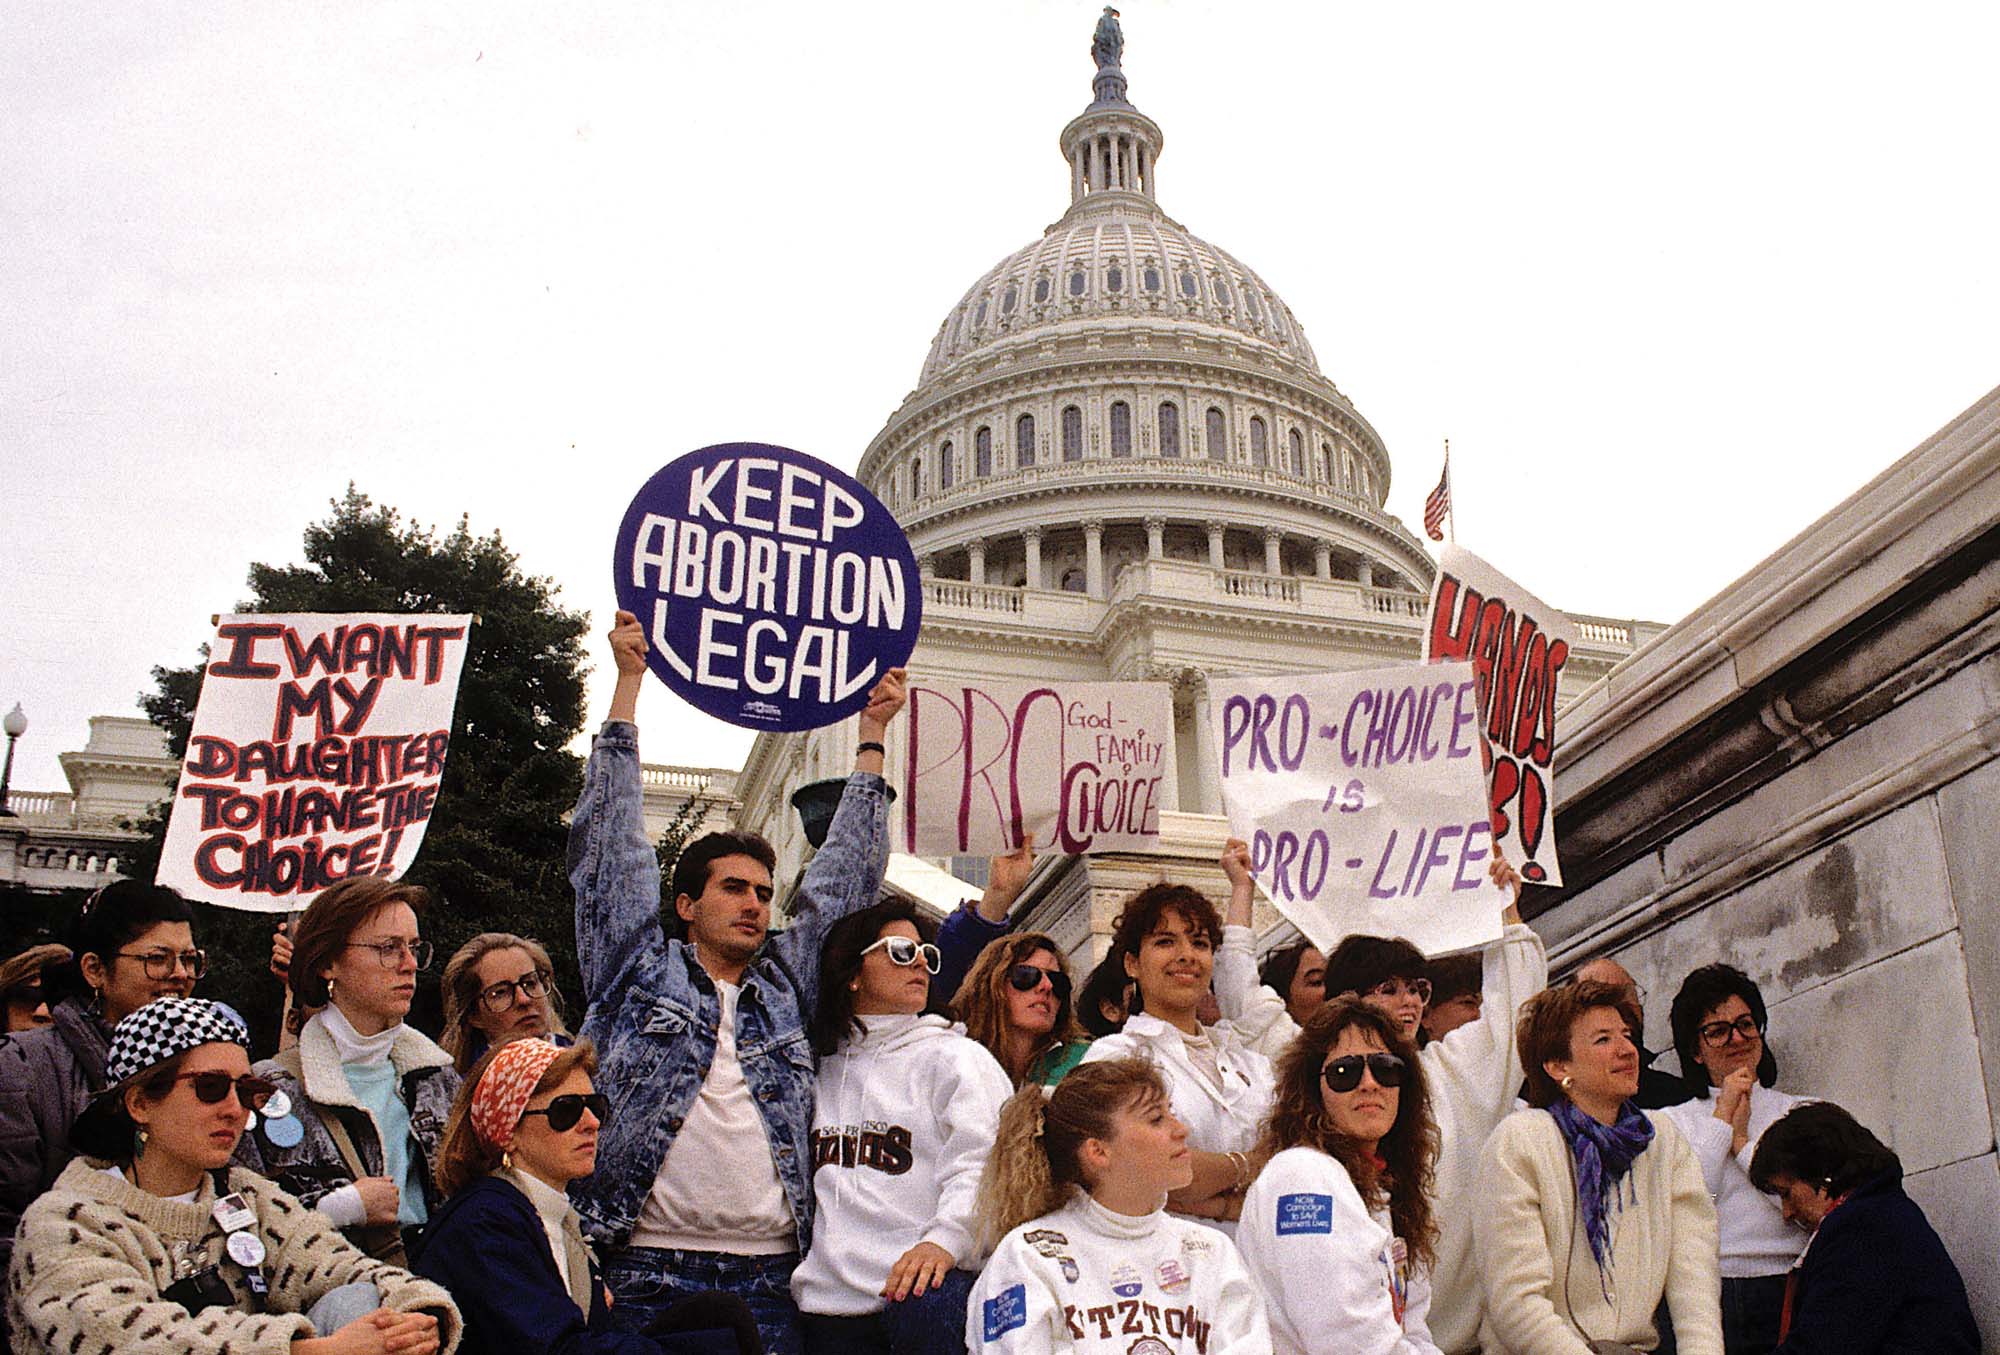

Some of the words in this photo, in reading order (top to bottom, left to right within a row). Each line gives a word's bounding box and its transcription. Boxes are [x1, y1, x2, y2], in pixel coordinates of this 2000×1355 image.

[688, 458, 865, 543] KEEP
[633, 511, 906, 631] ABORTION
[208, 623, 285, 680] I
[284, 623, 465, 686] WANT
[652, 598, 877, 704] LEGAL
[1428, 572, 1568, 768] HANDS
[272, 677, 384, 743] MY
[186, 729, 450, 787] DAUGHTER
[907, 687, 1064, 854] PRO
[183, 783, 260, 831] TO
[260, 786, 380, 839] HAVE
[376, 783, 439, 832] THE
[1322, 779, 1365, 814] IS
